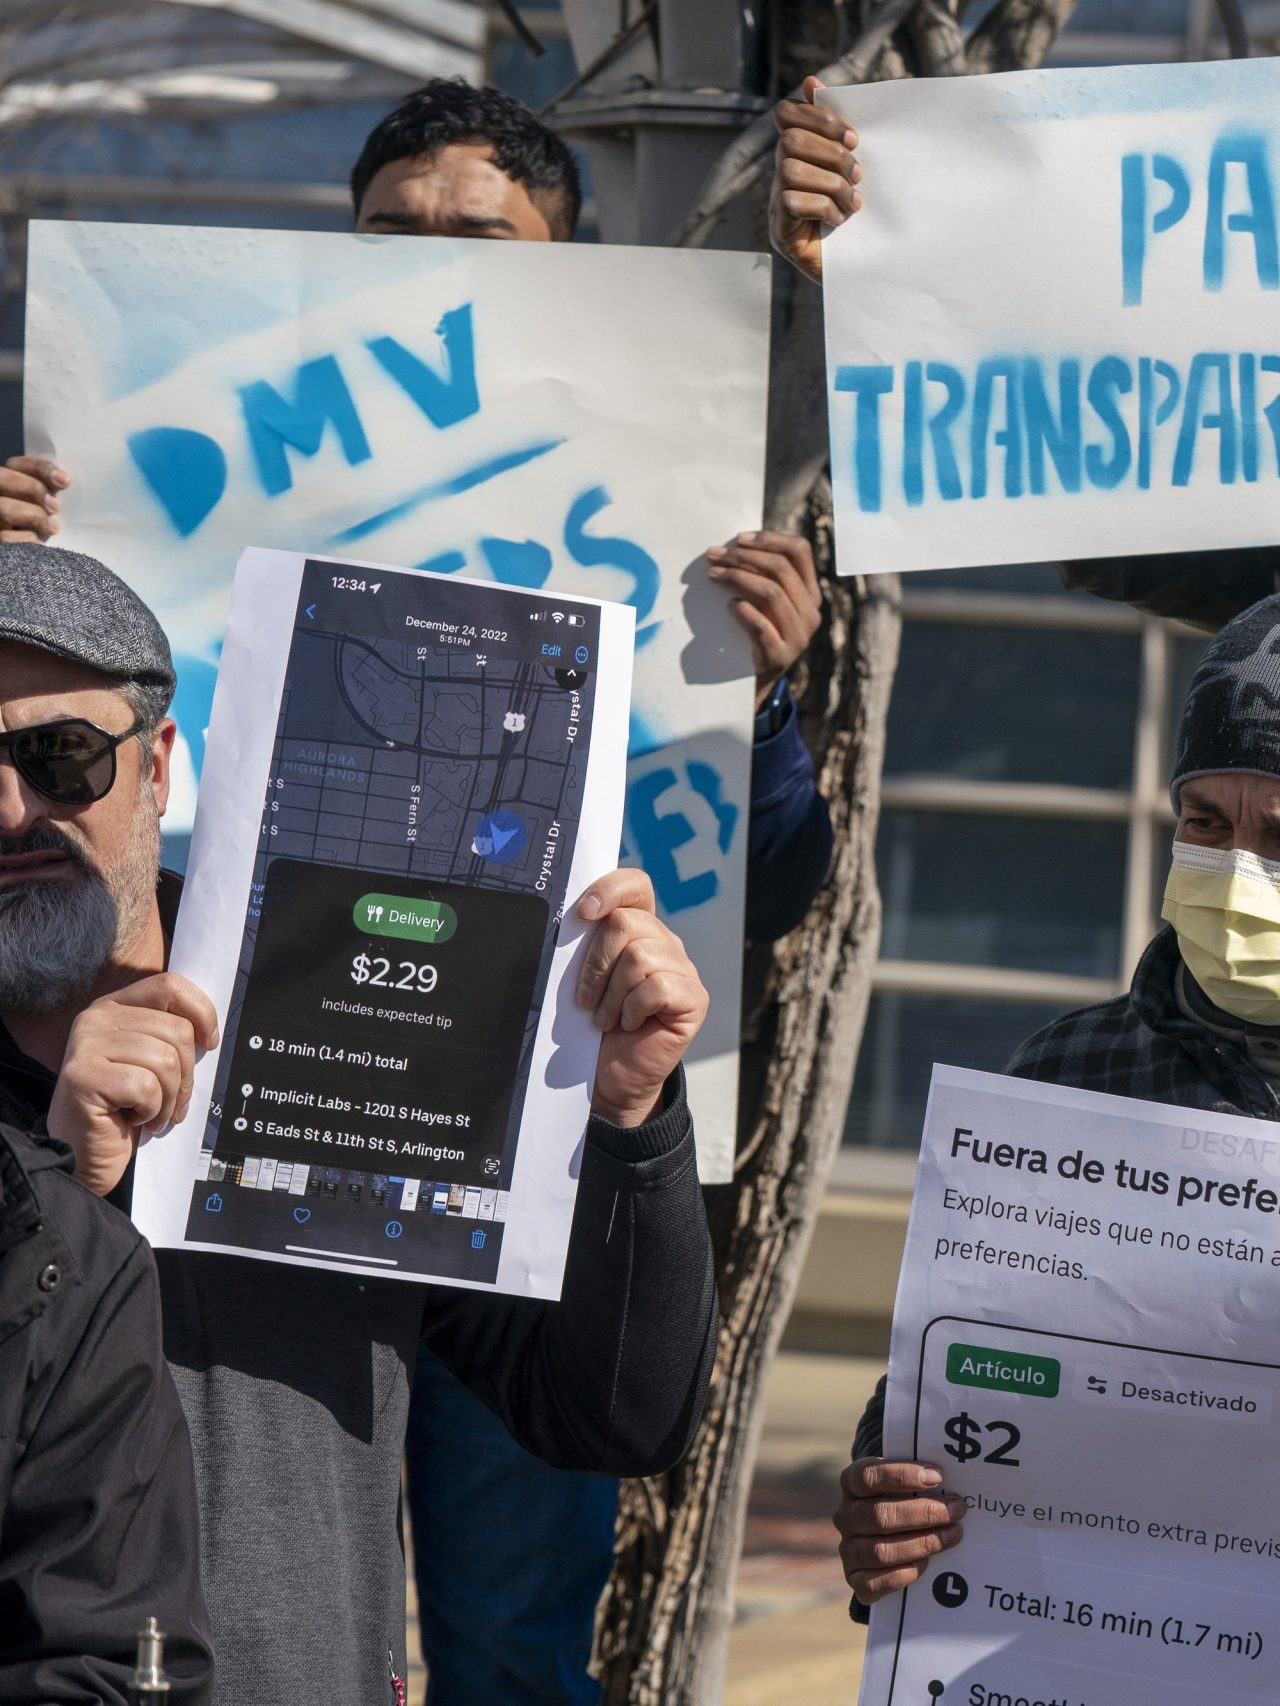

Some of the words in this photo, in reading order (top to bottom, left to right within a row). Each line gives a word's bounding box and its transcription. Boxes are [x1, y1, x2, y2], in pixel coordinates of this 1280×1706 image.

[126, 302, 481, 538] DMV
[332, 577, 366, 592] 12:34
[406, 616, 460, 633] December
[462, 625, 477, 638] 24,
[481, 628, 507, 642] 2022
[417, 647, 427, 660] St
[542, 644, 561, 657] Edit
[566, 726, 577, 743] Dr
[284, 761, 365, 783] HIGHLANDS
[298, 748, 356, 767] AURORA
[276, 779, 284, 789] S
[271, 801, 279, 811] S
[408, 797, 420, 824] Fern
[270, 825, 278, 835] S
[407, 828, 417, 842] St
[535, 841, 556, 890] Crystal
[548, 820, 560, 837] Dr
[389, 910, 444, 932] Delivery
[351, 953, 438, 993] $2.29
[322, 997, 374, 1016] includes
[376, 1009, 433, 1025] expected
[436, 1015, 452, 1030] tip
[268, 1039, 285, 1052] 18
[288, 1043, 315, 1057] min
[319, 1045, 344, 1061] (1.4
[347, 1052, 372, 1067] mi)
[375, 1055, 408, 1071] total
[260, 1087, 315, 1106] Implicit
[317, 1095, 351, 1111] Labs
[364, 1102, 395, 1118] 1201
[398, 1107, 408, 1119] S
[410, 1108, 452, 1126] Hayes
[455, 1114, 470, 1127] St
[254, 1120, 263, 1133] S
[266, 1122, 300, 1138] Eads
[304, 1128, 320, 1141] St
[322, 1131, 333, 1143] &
[335, 1132, 365, 1148] 11th
[368, 1137, 384, 1151] St
[386, 1140, 398, 1155] S,
[401, 1142, 464, 1161] Arlington
[951, 1128, 1047, 1174] Fuera
[1057, 1150, 1104, 1183] de
[1114, 1159, 1169, 1195] tus
[943, 1188, 1027, 1223] Explora
[1035, 1206, 1101, 1236] viajes
[1108, 1222, 1153, 1245] que
[1161, 1229, 1190, 1251] no
[1198, 1238, 1263, 1263] están
[935, 1238, 1087, 1281] preferencias.
[960, 1358, 1045, 1385] Artículo
[1122, 1382, 1256, 1413] Desactivado
[944, 1412, 1021, 1467] $2
[941, 1489, 1025, 1518] cluye
[1033, 1506, 1052, 1521] el
[1061, 1511, 1140, 1534] monto
[1148, 1523, 1207, 1545] extra
[984, 1585, 1056, 1620] Total:
[1063, 1601, 1093, 1627] 16
[1101, 1611, 1152, 1638] min
[1161, 1617, 1211, 1646] (1.7
[1217, 1632, 1263, 1660] mi)
